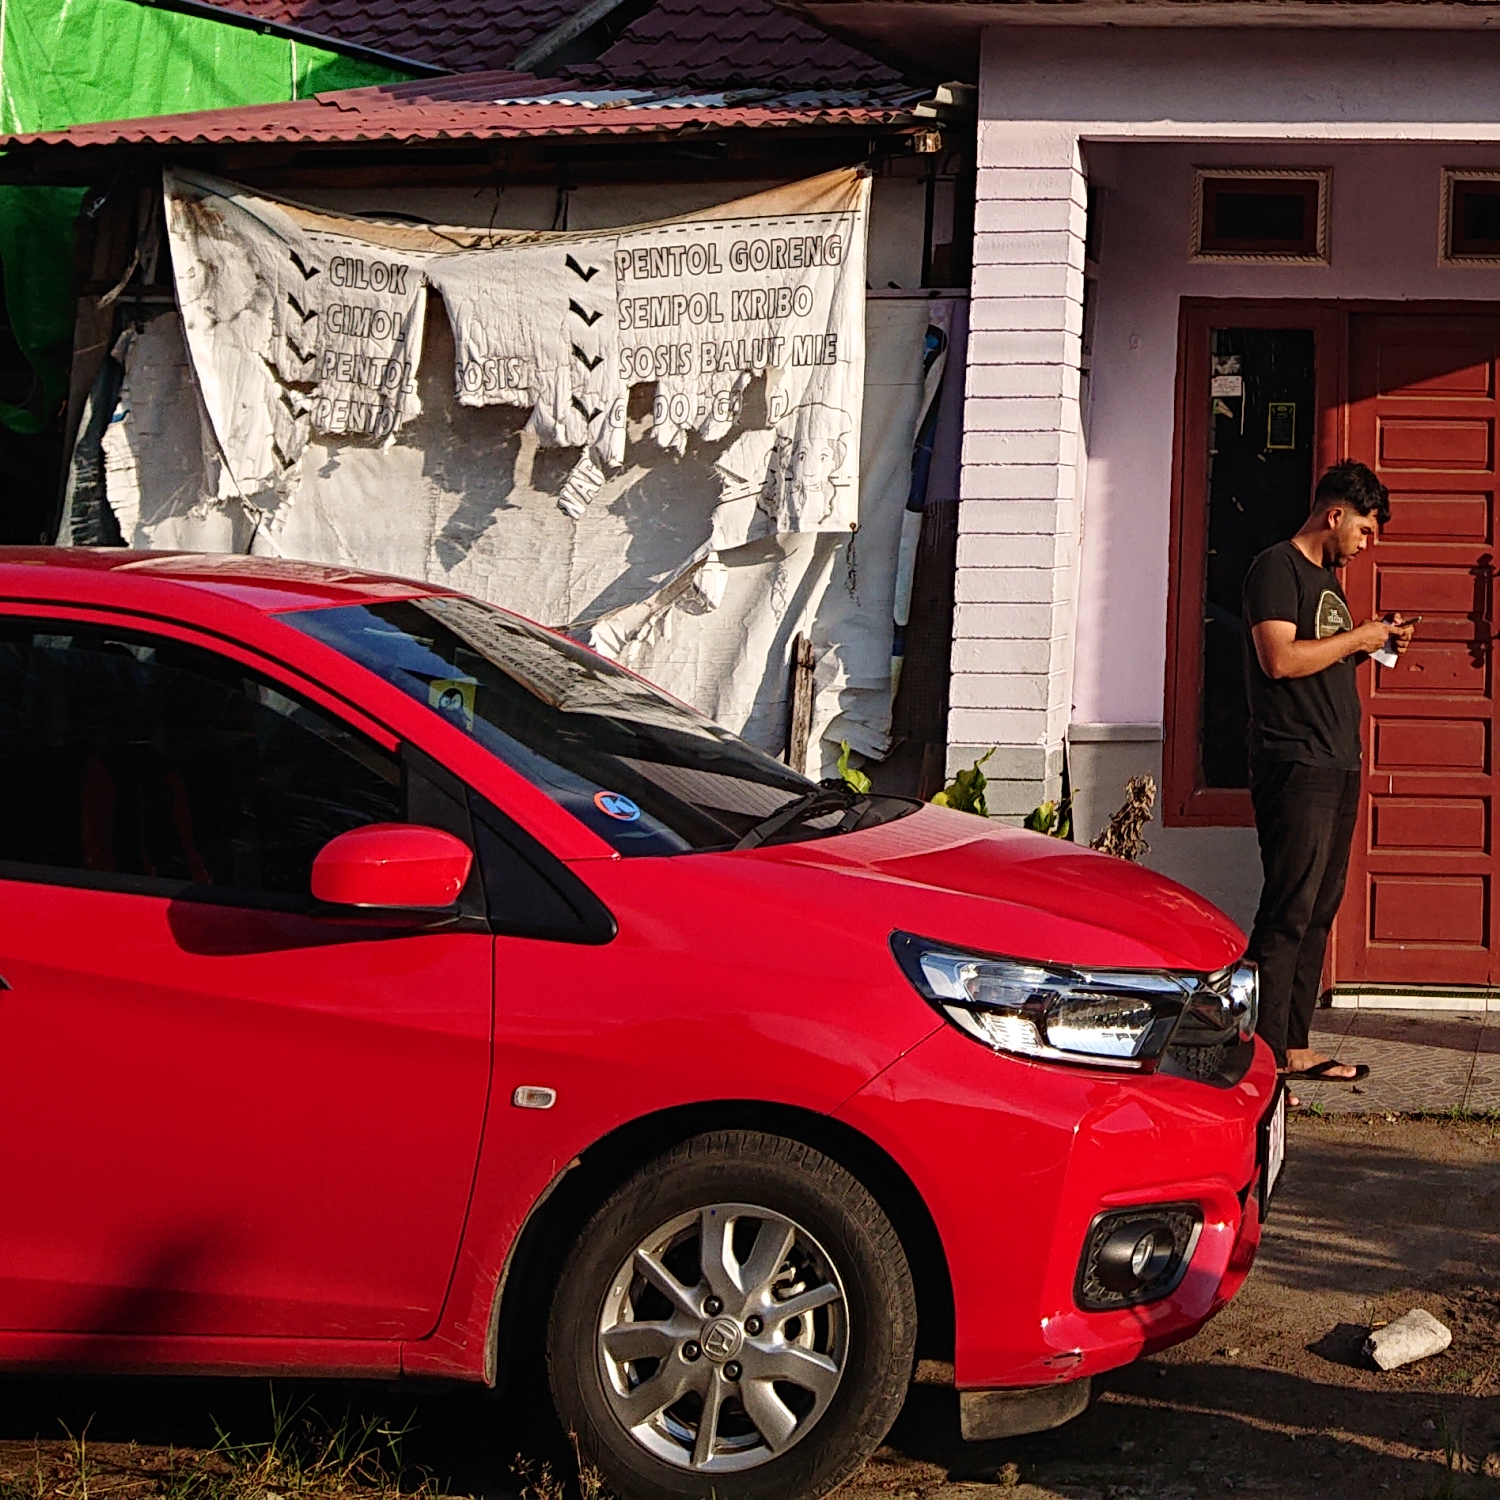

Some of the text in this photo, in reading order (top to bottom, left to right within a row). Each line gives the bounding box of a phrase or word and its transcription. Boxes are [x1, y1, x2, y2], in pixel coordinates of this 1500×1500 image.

[329, 256, 409, 295] CILOK
[614, 235, 842, 280] PENTOL GORENG
[326, 303, 406, 341] CIMOL
[619, 285, 813, 330] SEMPOL KRIBO
[321, 350, 414, 393] PENTOL
[619, 334, 837, 379] SOSIS BALUT MIE
